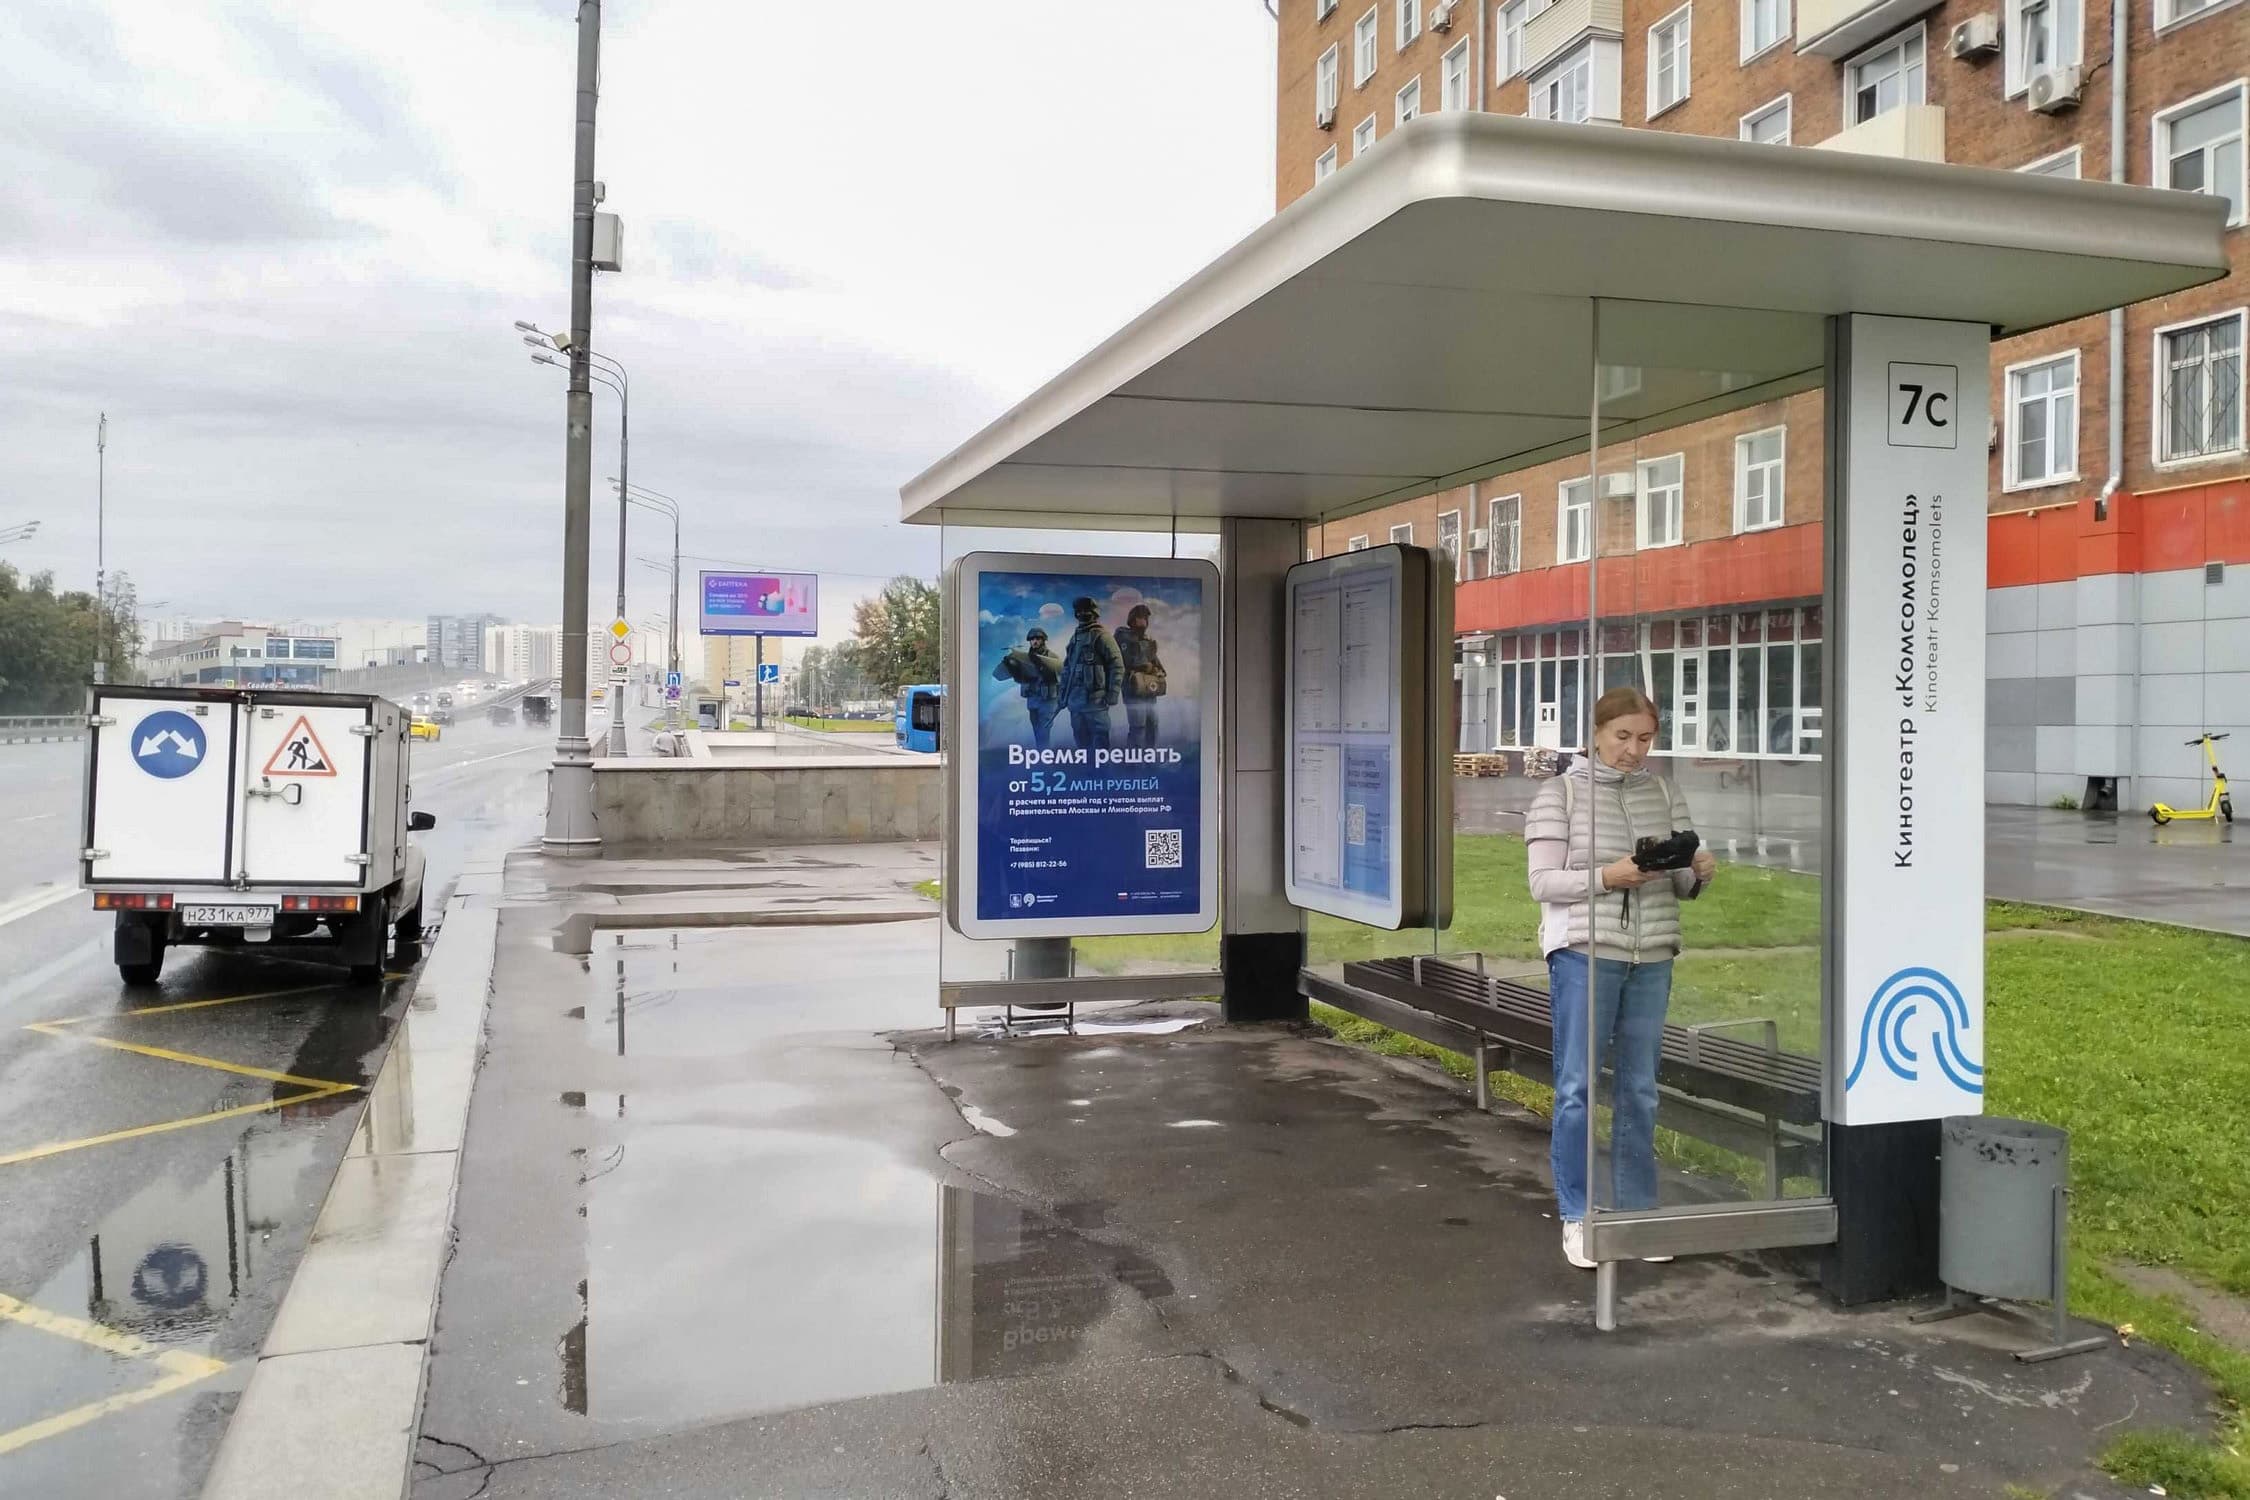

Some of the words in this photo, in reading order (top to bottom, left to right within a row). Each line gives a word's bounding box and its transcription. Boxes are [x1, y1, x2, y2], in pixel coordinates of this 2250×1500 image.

[1927, 494, 1942, 621] Komsomolets
[1895, 494, 1920, 708] «Комсомолец»
[1925, 625, 1939, 713] Kinoteatr
[1008, 744, 1087, 769] Время
[1095, 747, 1181, 768] решать
[1009, 780, 1028, 792] от
[1030, 771, 1067, 795] 5,2
[1070, 780, 1103, 791] МЛН
[1107, 777, 1159, 790] РУБЛЕЙ
[1895, 718, 1917, 867] Кинотеатр
[1009, 808, 1067, 816] Правительства
[1068, 806, 1100, 814] Москвы
[1108, 805, 1158, 814] Минобороны
[1015, 799, 1046, 807] расчете
[1058, 797, 1088, 806] первый
[1108, 797, 1136, 805] учетом
[187, 907, 245, 922] Н231КА
[247, 907, 270, 918] 977
